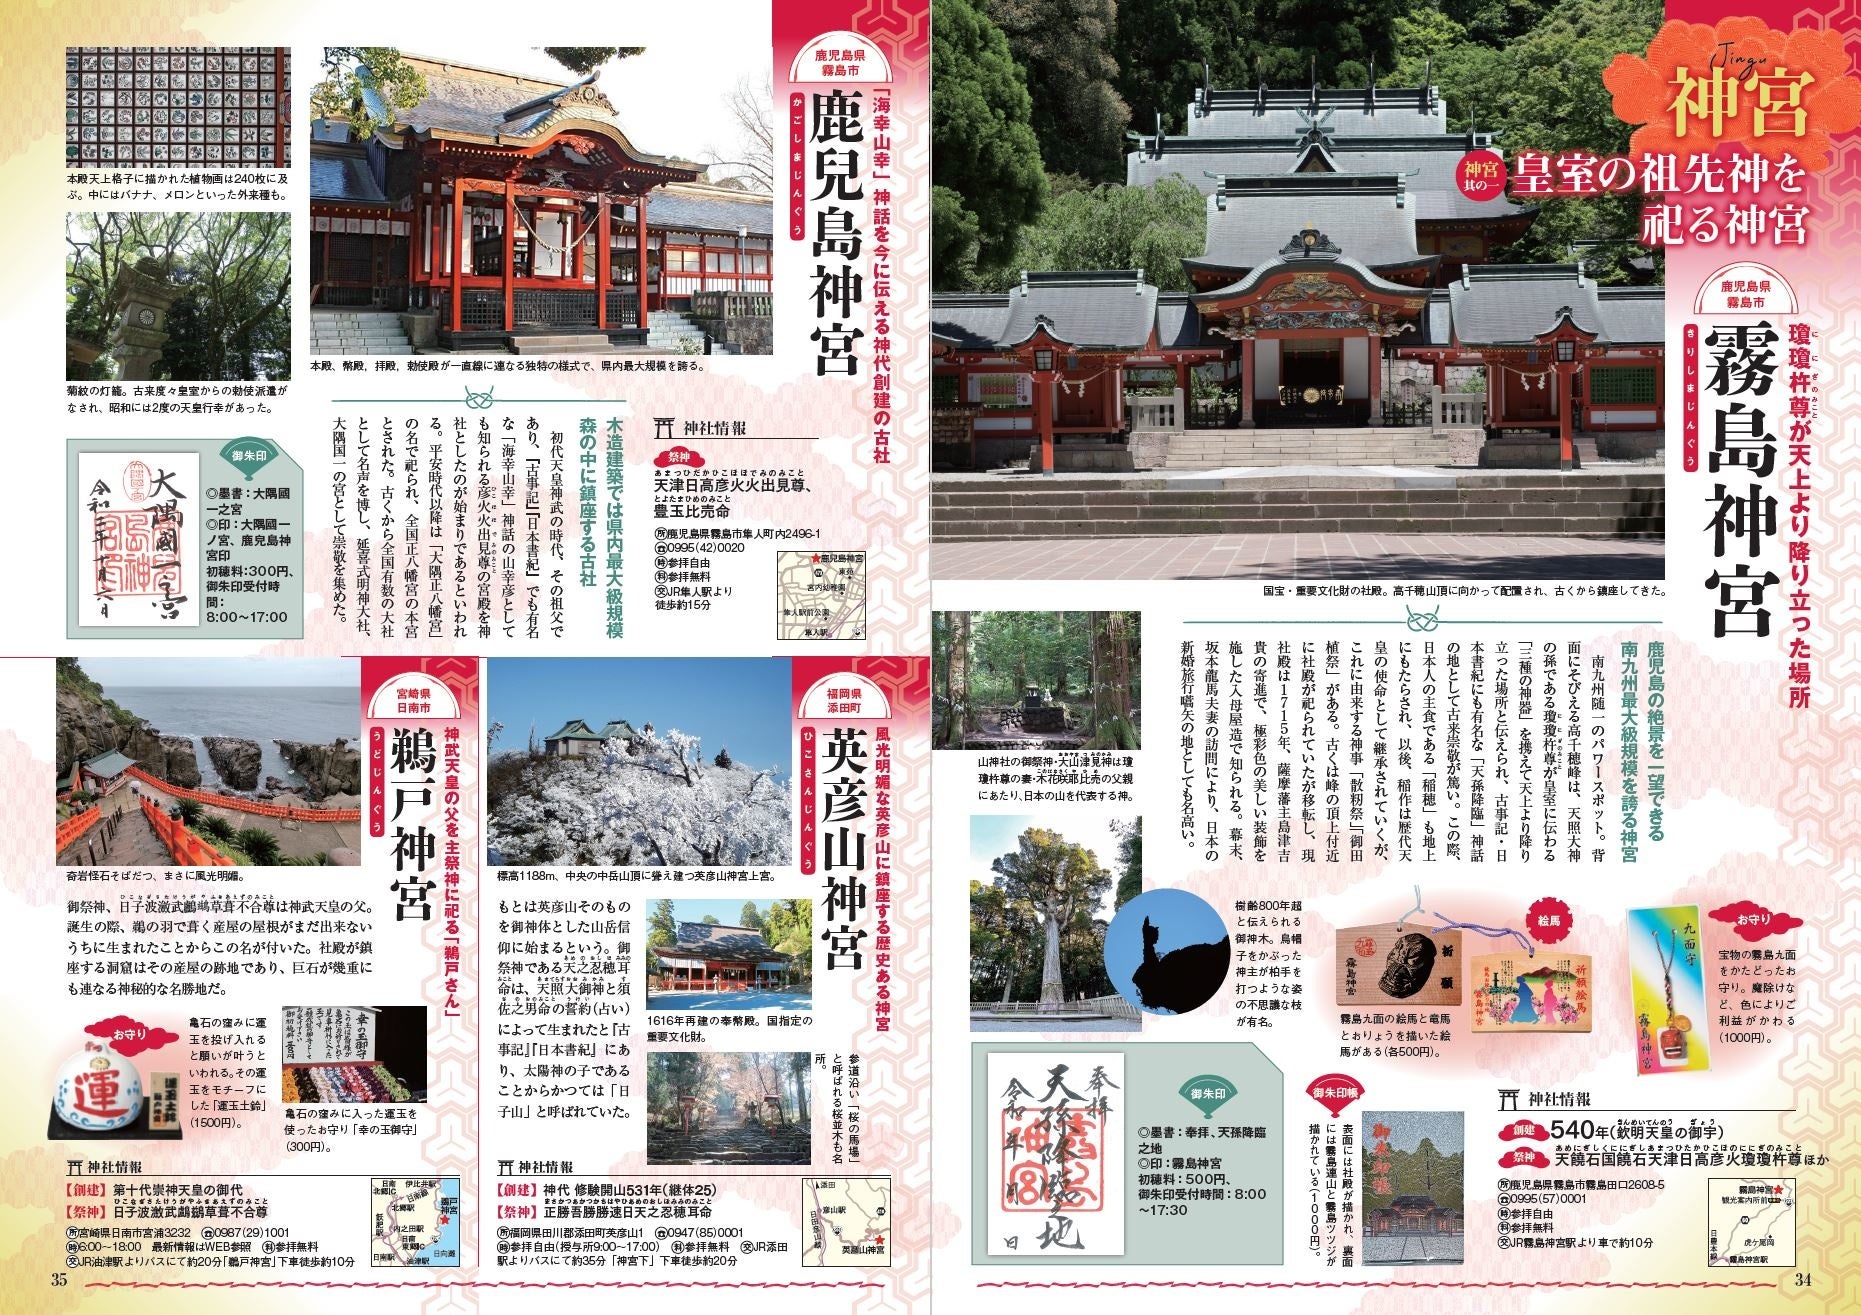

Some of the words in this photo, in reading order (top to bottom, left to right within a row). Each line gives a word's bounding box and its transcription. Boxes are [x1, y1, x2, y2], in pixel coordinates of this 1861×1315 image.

[816, 49, 865, 61] 鹿児島県
[1710, 42, 1767, 81] Jingu
[823, 65, 859, 76] 霧島市
[1666, 67, 1815, 138] 神宮
[793, 98, 801, 235] かごしまじんぐう
[1465, 160, 1498, 175] 神宮
[1514, 154, 1806, 194] 皇室の祖先神を
[1464, 179, 1499, 191] 其の一
[1640, 204, 1808, 245] 祀る神宮
[809, 89, 864, 376] 鹿兒島神宮
[1722, 280, 1771, 292] 鹿児島県
[1728, 296, 1764, 308] 霧島市
[1687, 329, 1695, 466] きりしまじんぐう
[685, 421, 746, 435] 神社情報
[232, 451, 267, 461] 御朱印
[668, 452, 690, 462] 祭神
[1704, 320, 1780, 638] 霧島神宮
[579, 417, 596, 587] 森の中に鎮座する古社
[207, 503, 242, 515] 一之宮
[654, 502, 730, 518] 豊玉比売命
[1788, 323, 1811, 708] 瓊瓊杵尊が天上より降り立った場所
[606, 417, 623, 639] 木造建築では県内最大級規模
[206, 549, 230, 561] 宮印
[207, 580, 280, 592] 御朱印受付時
[655, 600, 711, 610] 徒歩約15分
[397, 688, 430, 699] 宮崎県
[827, 688, 861, 699] 福岡県
[398, 702, 430, 713] 日南市
[828, 703, 861, 713] 添田町
[1648, 641, 1665, 841] 鹿児島の絶景を一望できる
[1621, 641, 1638, 862] 南九州最大級規模を誇る神宮
[373, 732, 382, 833] うどじんぐう
[391, 727, 436, 921] 鵜戸神宮
[822, 728, 867, 970] 英彦山神宮
[875, 727, 890, 1031] 風光明媚な英彦山に鎮座する歴史ある神宮
[500, 900, 630, 913] もとは英彦山そのもの
[1235, 901, 1301, 911] 樹齢800年超
[1238, 917, 1300, 927] と伝えられる
[1538, 916, 1560, 926] 絵馬
[1738, 914, 1770, 925] お守り
[499, 920, 630, 934] を御神体とした山岳信
[498, 941, 630, 955] 仰に始まるという。御
[1684, 923, 1696, 966] 九面守
[1236, 951, 1301, 961] 子をかぶった
[1719, 950, 1796, 960] 宝物の霧島九面
[1236, 966, 1300, 977] 神主が柏手を
[1721, 966, 1795, 976] をかたどったお
[1236, 983, 1302, 994] 打つような姿
[1576, 965, 1587, 1013] 祈願絵馬
[1719, 982, 1794, 993] 守り。魔除けな
[1236, 999, 1301, 1010] の不思議な枝
[1720, 999, 1795, 1010] ど、色によりご
[190, 1017, 266, 1028] 亀石の窪みに運
[1237, 1016, 1272, 1027] が有名。
[1341, 1013, 1450, 1024] 霧島九面の絵馬と竜馬
[1719, 1015, 1794, 1026] 利益がかわる
[114, 1029, 146, 1040] お守り
[189, 1034, 265, 1045] 玉を投げ入れる
[647, 1031, 705, 1042] 重要文化財。
[1342, 1030, 1451, 1041] とおりょうを描いた絵
[191, 1050, 264, 1061] と願いが叶うと
[190, 1068, 266, 1078] いわれる。その運
[500, 1064, 629, 1077] り、太陽神の子である
[74, 1070, 129, 1118] 運
[189, 1085, 265, 1095] 玉をモチーフに
[499, 1084, 628, 1097] ことからかつては「日
[1191, 1088, 1226, 1100] 御朱印
[1313, 1088, 1358, 1098] 御朱印帳
[1530, 1092, 1590, 1107] 神社情報
[832, 1054, 843, 1164] と呼ばれる桜並木も名
[1513, 1125, 1534, 1135] 創建
[1139, 1143, 1162, 1154] 之地
[1512, 1152, 1534, 1162] 祭神
[88, 1161, 142, 1174] 神社情報
[517, 1161, 575, 1176] 神社情報
[66, 1183, 106, 1197] 【創建】
[113, 1184, 243, 1196] 第十代崇神天皇の御代
[497, 1183, 536, 1197] 【創建】
[543, 1184, 570, 1196] 神代
[1326, 1124, 1337, 1266] には霧島連山と霧島ツツジが
[66, 1205, 106, 1218] 【祭神】
[497, 1205, 536, 1219] 【祭神】
[52, 1273, 67, 1287] 35
[1795, 1273, 1811, 1286] 34
